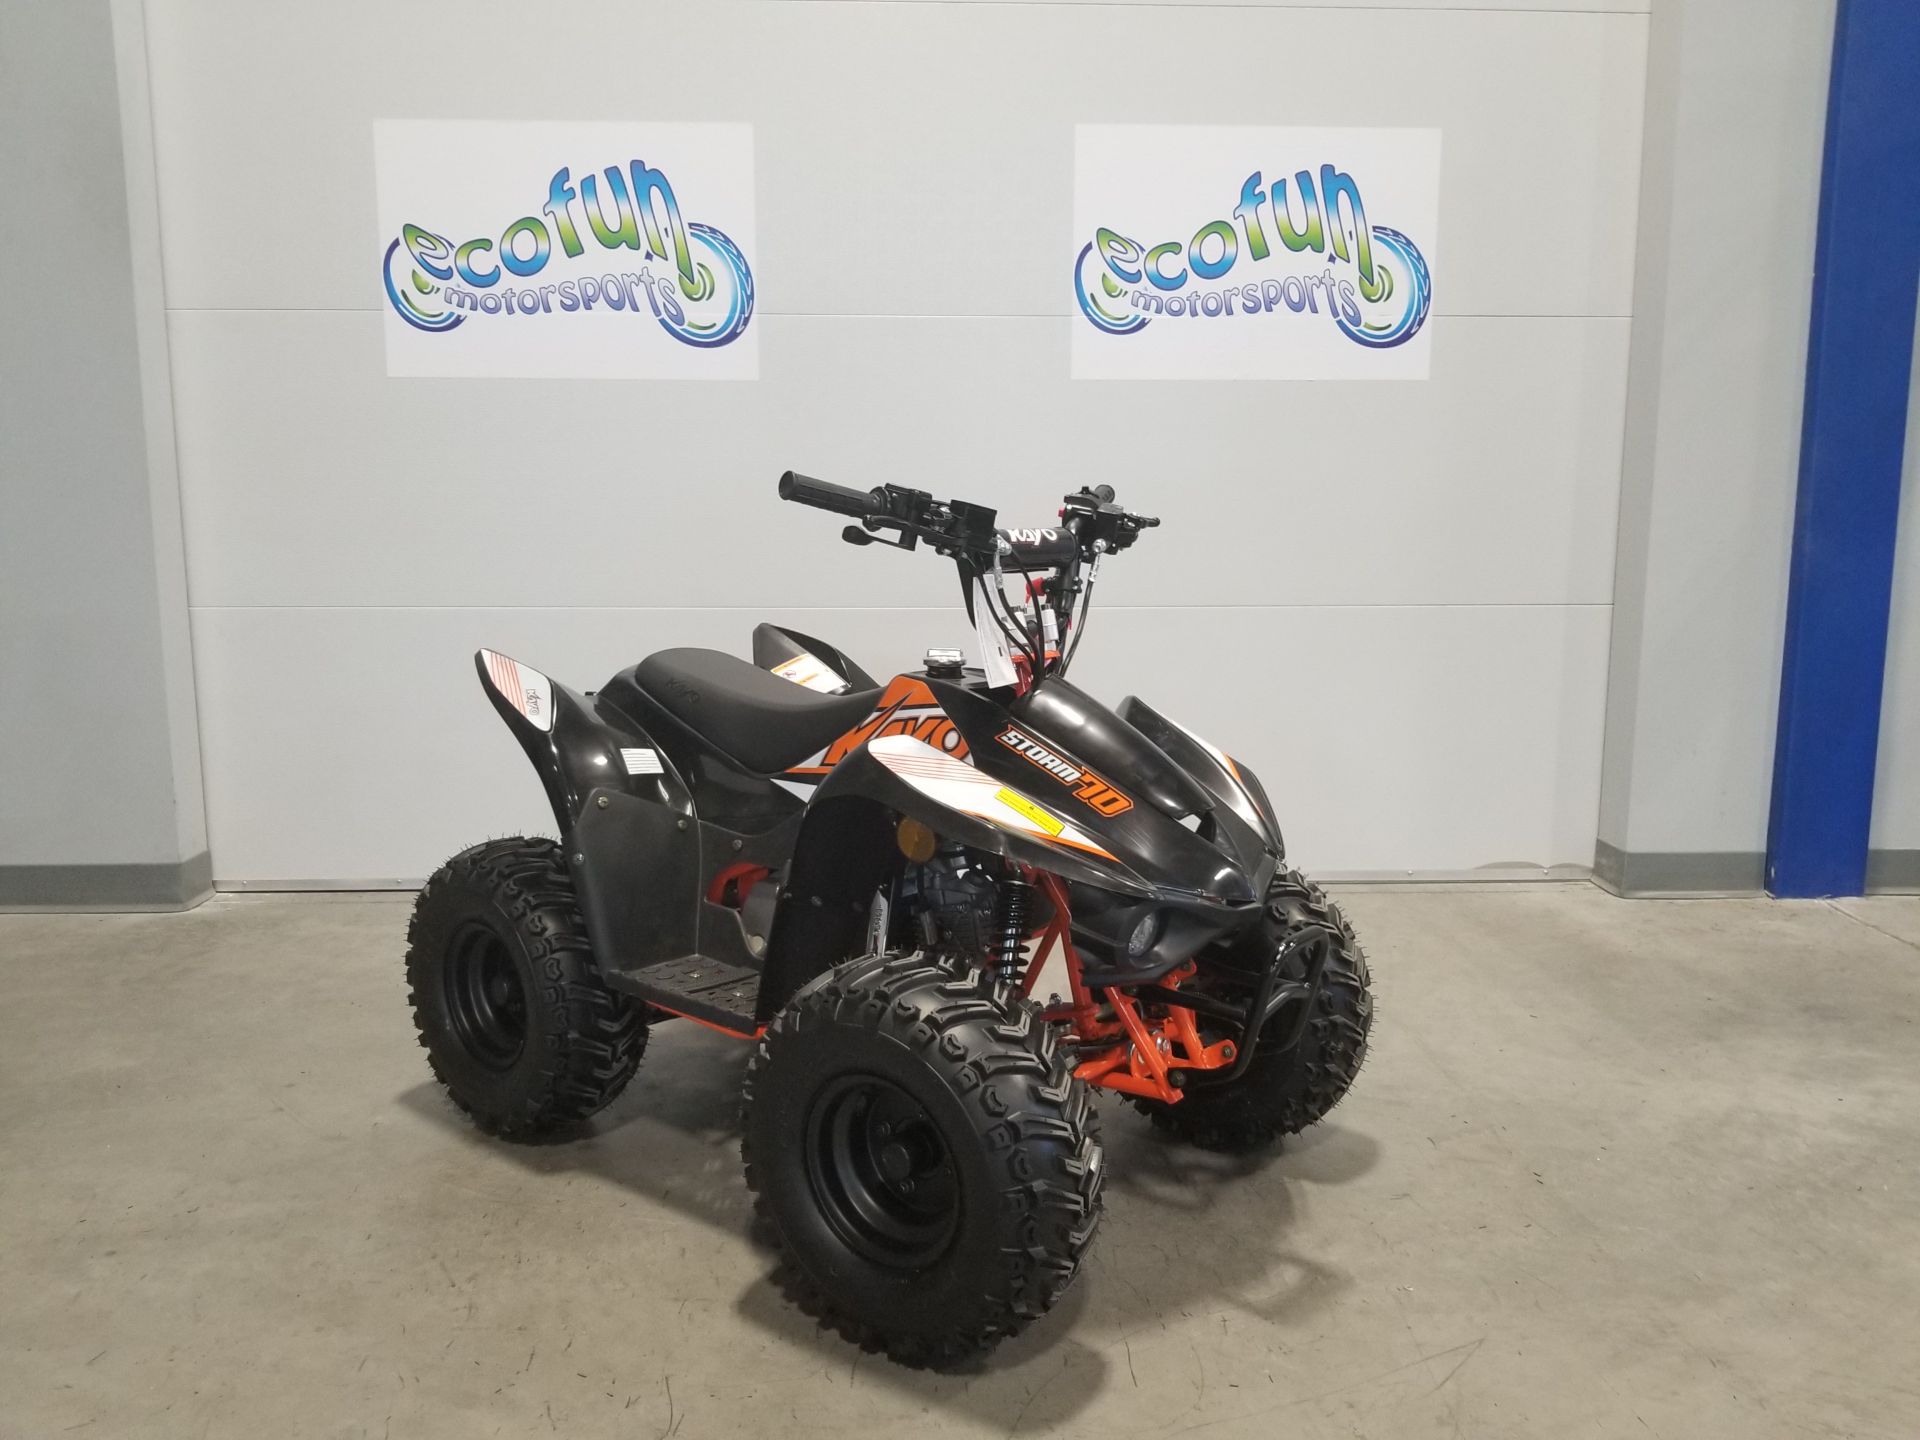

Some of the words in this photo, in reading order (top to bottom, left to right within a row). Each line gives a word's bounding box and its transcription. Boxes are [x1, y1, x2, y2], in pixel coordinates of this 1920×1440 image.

[403, 159, 695, 288] ecofun
[1096, 164, 1374, 291] ecofun
[444, 266, 685, 327] motorsports
[1131, 269, 1362, 328] motorsports
[1000, 730, 1082, 782] STORM
[1076, 772, 1132, 815] 70
